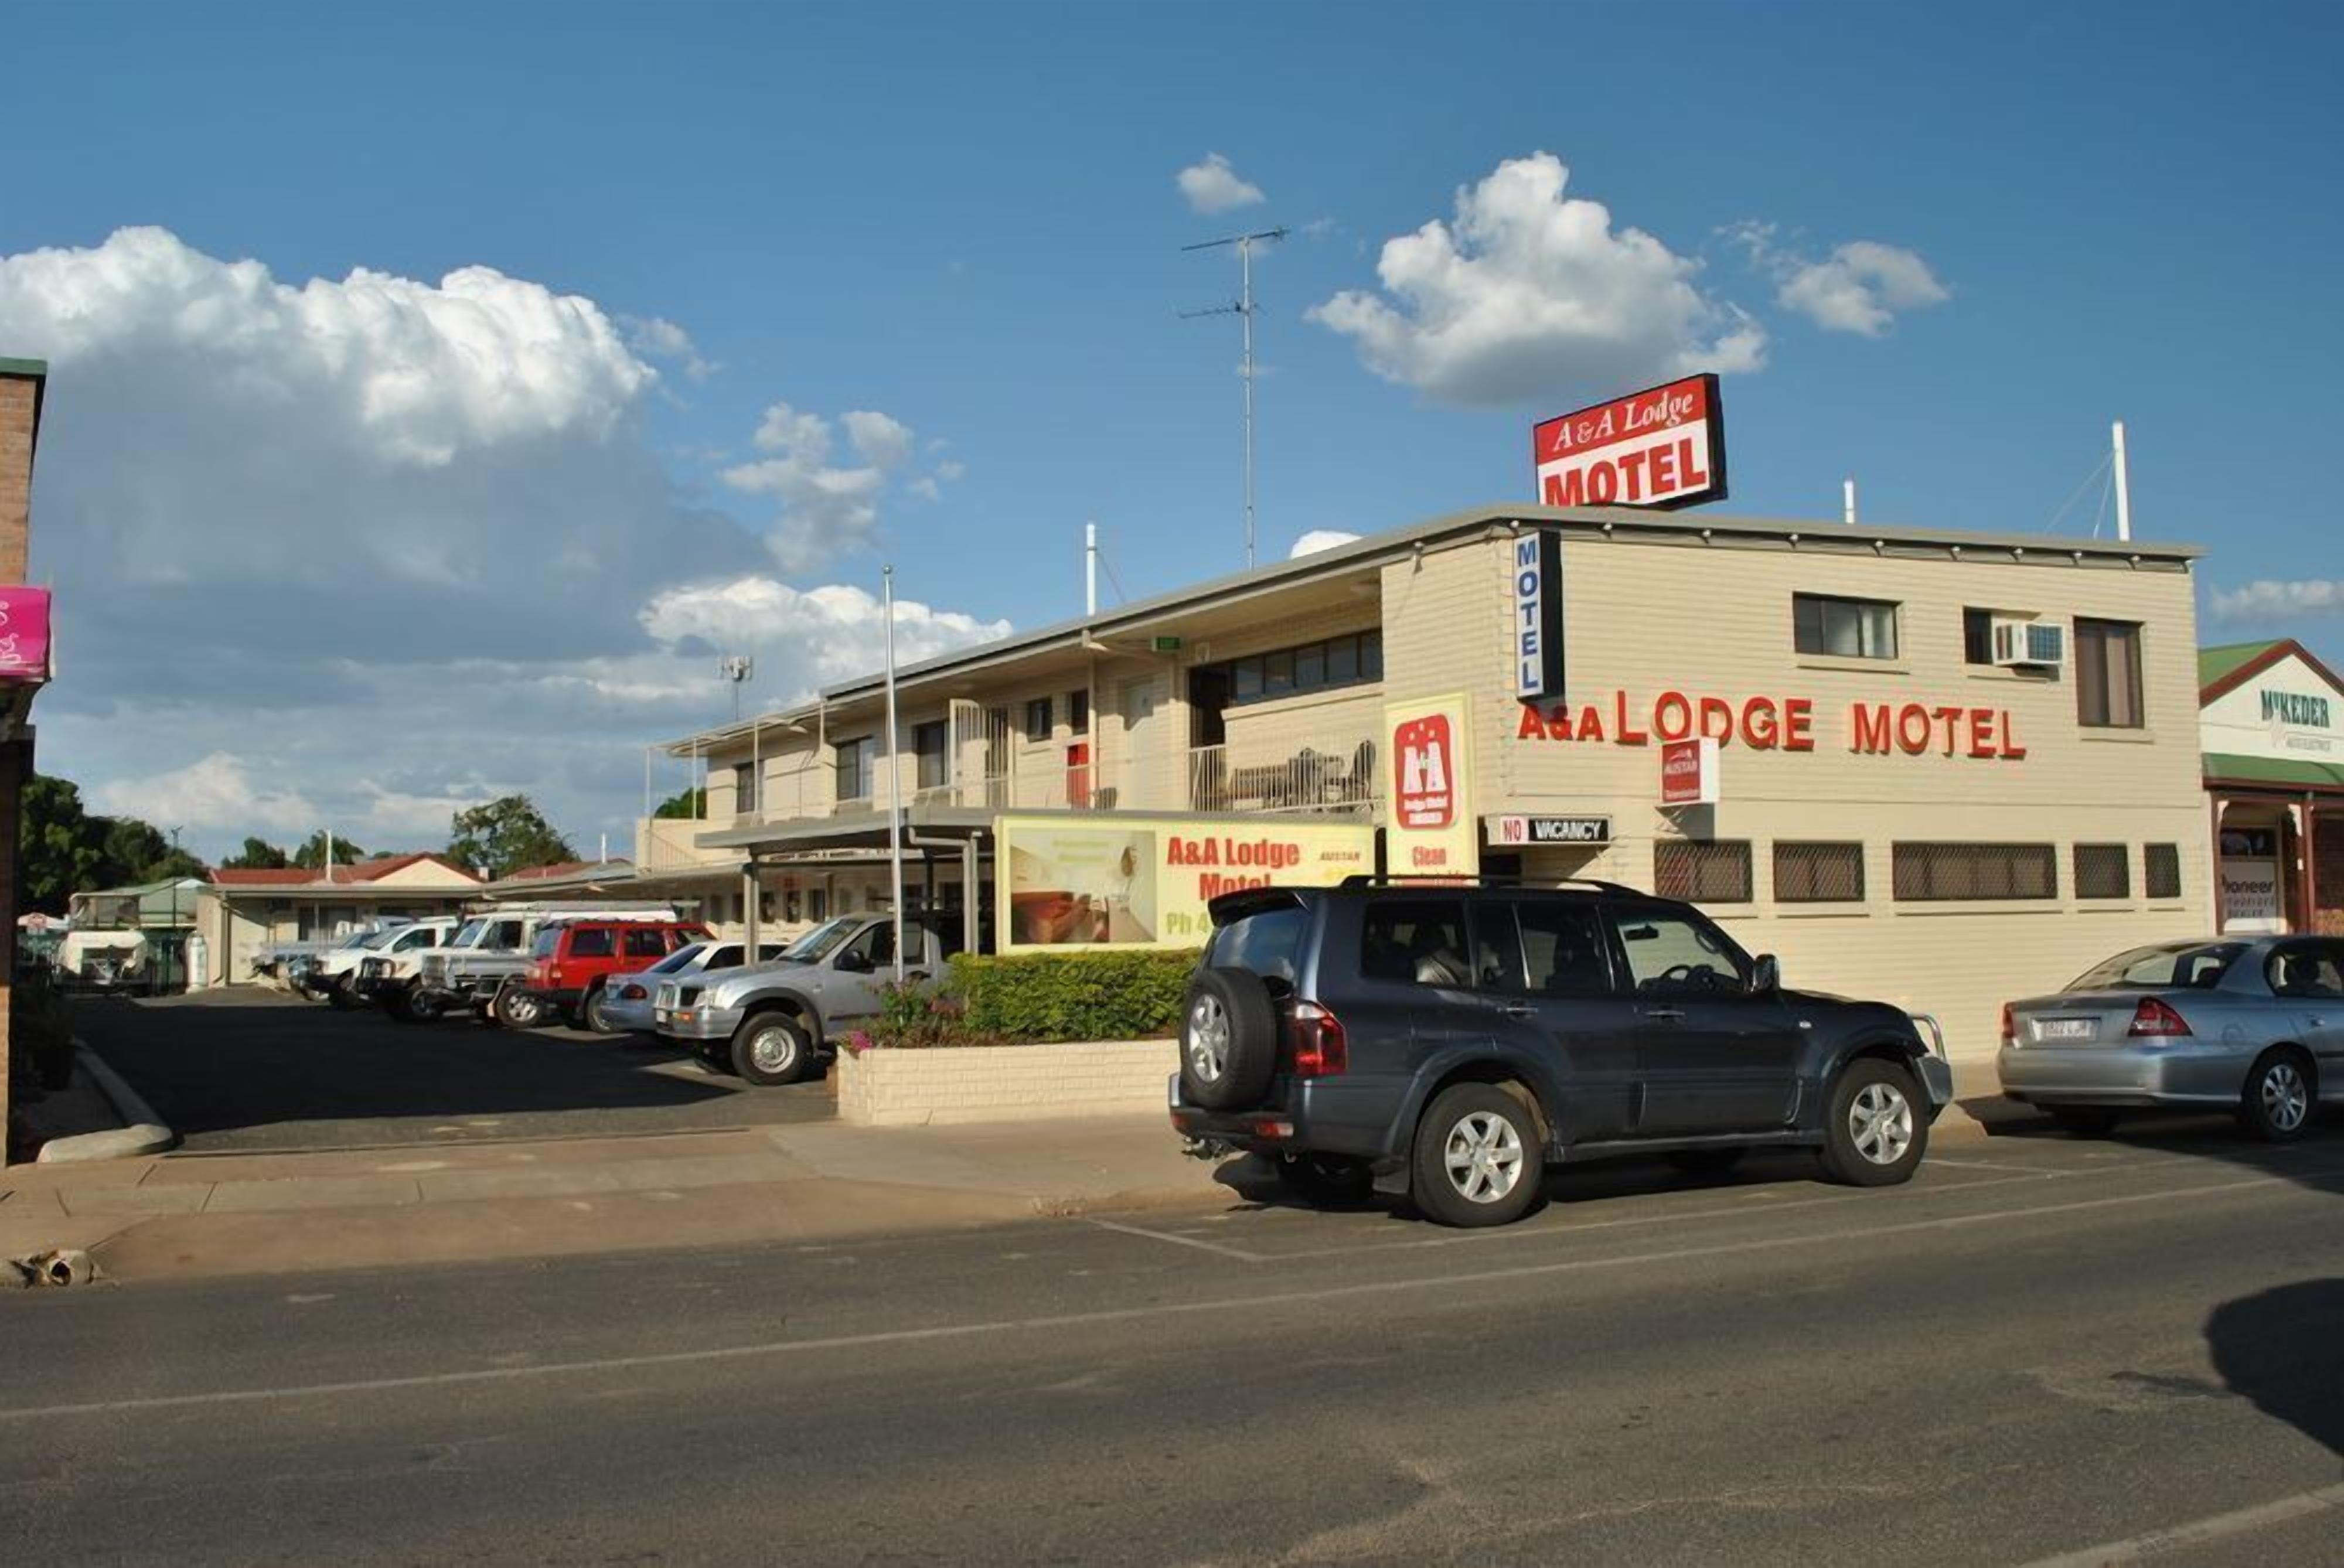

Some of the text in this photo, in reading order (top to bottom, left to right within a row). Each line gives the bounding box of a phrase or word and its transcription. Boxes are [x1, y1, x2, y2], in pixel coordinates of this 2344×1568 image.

[1624, 391, 1693, 431] Lodge
[1545, 437, 1706, 506] MOTEL
[1517, 539, 1538, 689] MOTEL
[1616, 690, 1814, 751] LODGE
[1850, 703, 2026, 759] MOTEL
[1503, 819, 1602, 841] NO VACANCY
[1167, 837, 1300, 869] A&A Lodge
[1167, 912, 1193, 935] Ph
